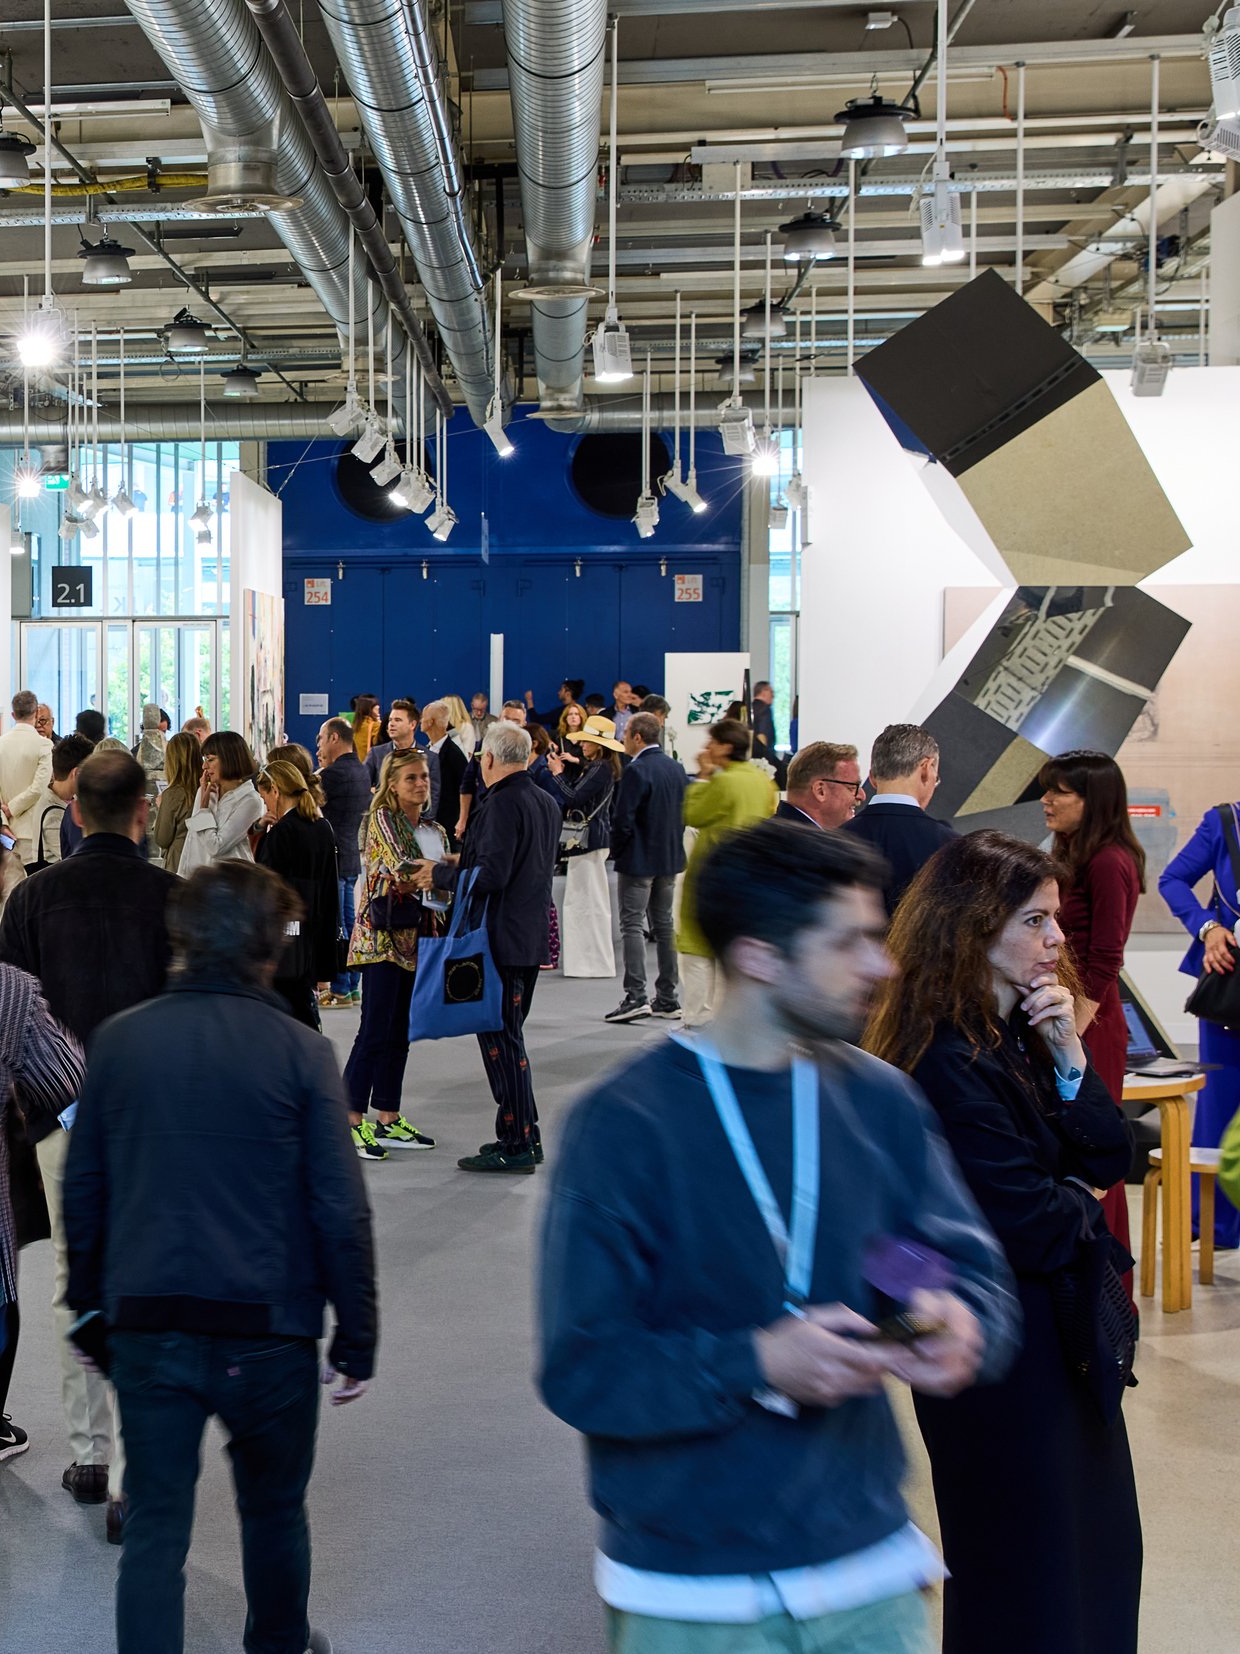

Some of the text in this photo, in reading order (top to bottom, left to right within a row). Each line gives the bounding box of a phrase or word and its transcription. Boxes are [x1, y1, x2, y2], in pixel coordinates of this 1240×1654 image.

[56, 583, 85, 604] 2.1
[306, 591, 329, 604] 254
[677, 588, 700, 600] 255
